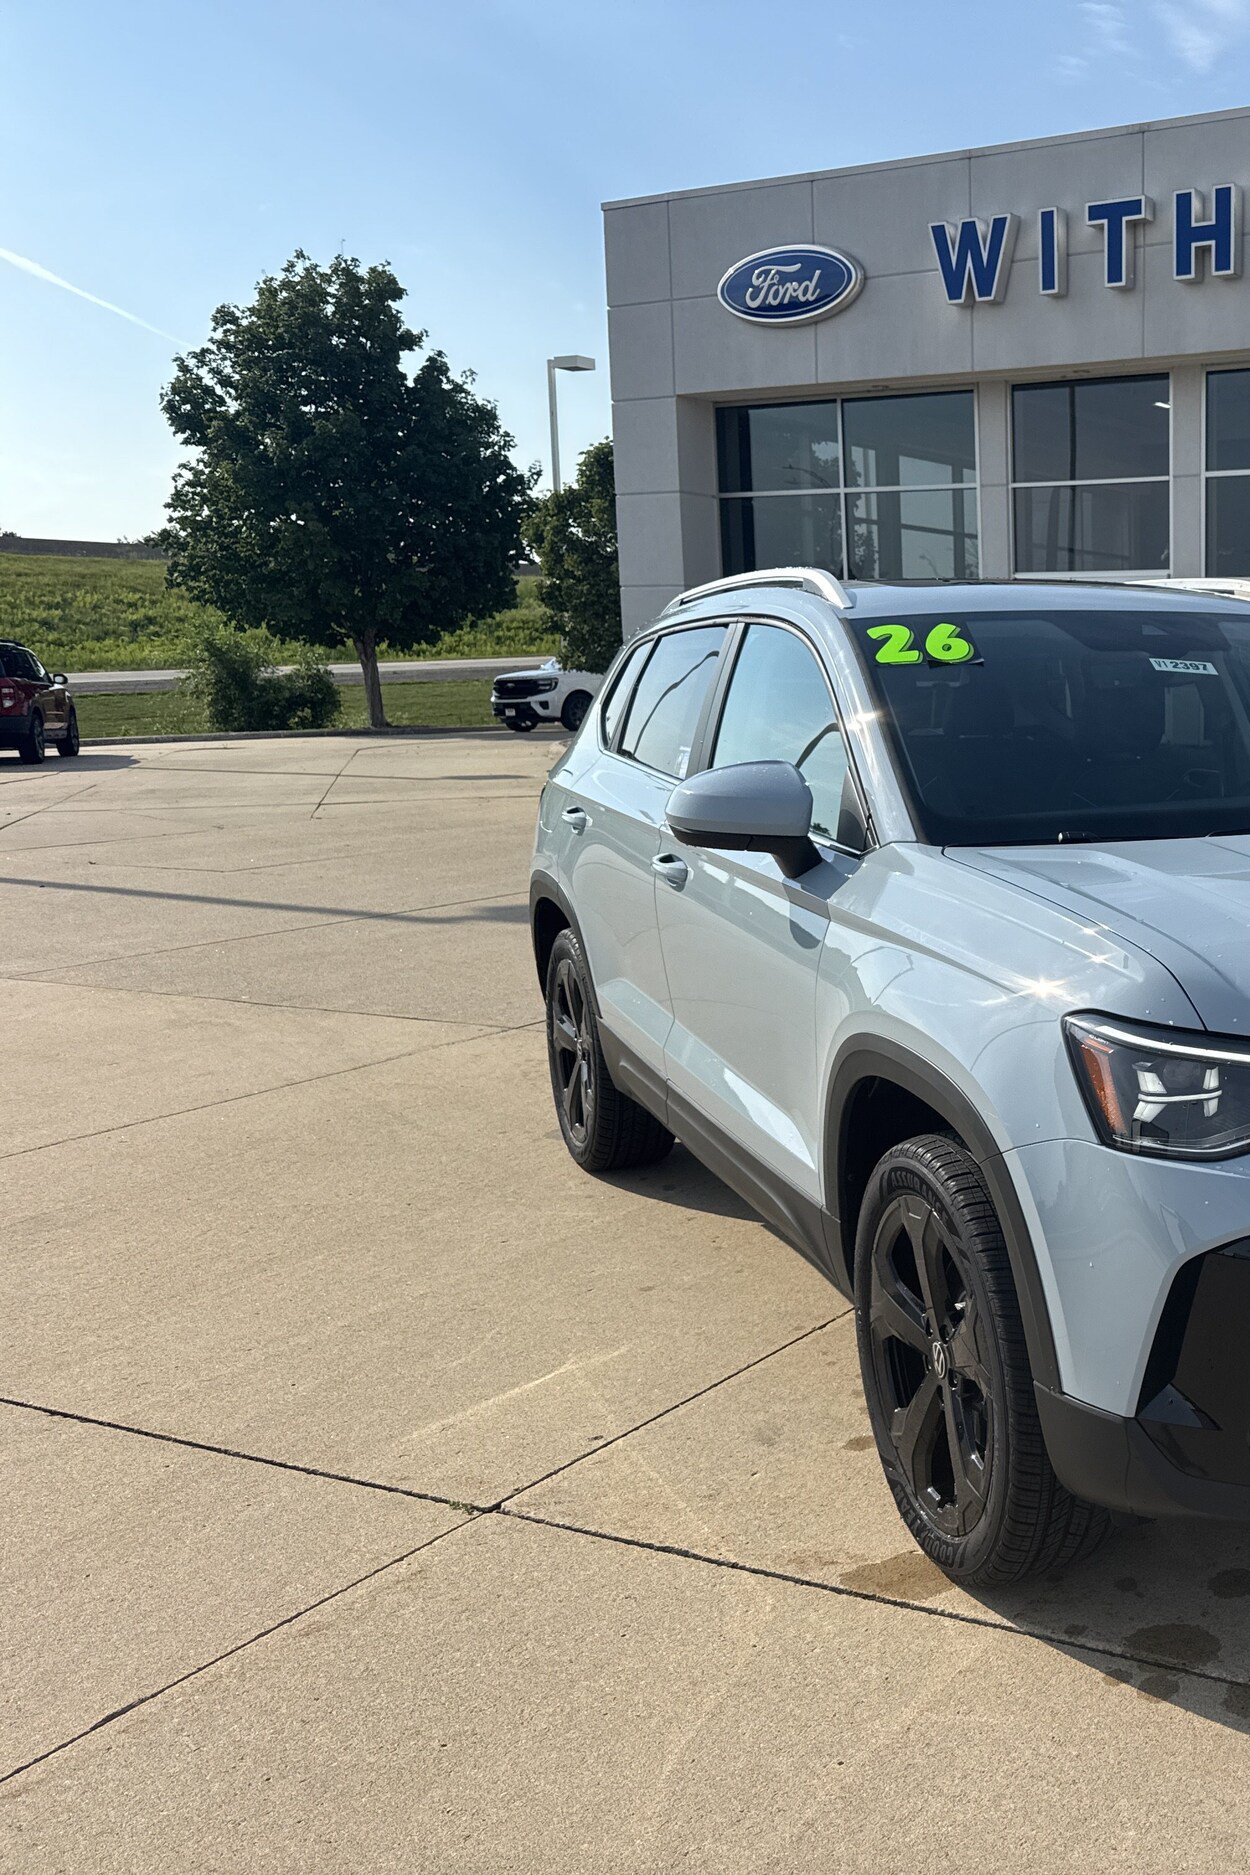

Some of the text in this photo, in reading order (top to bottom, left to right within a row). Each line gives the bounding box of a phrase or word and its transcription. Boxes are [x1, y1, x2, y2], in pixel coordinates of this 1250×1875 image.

[745, 263, 821, 309] Ford
[866, 622, 975, 665] 26
[1169, 661, 1208, 671] 2397
